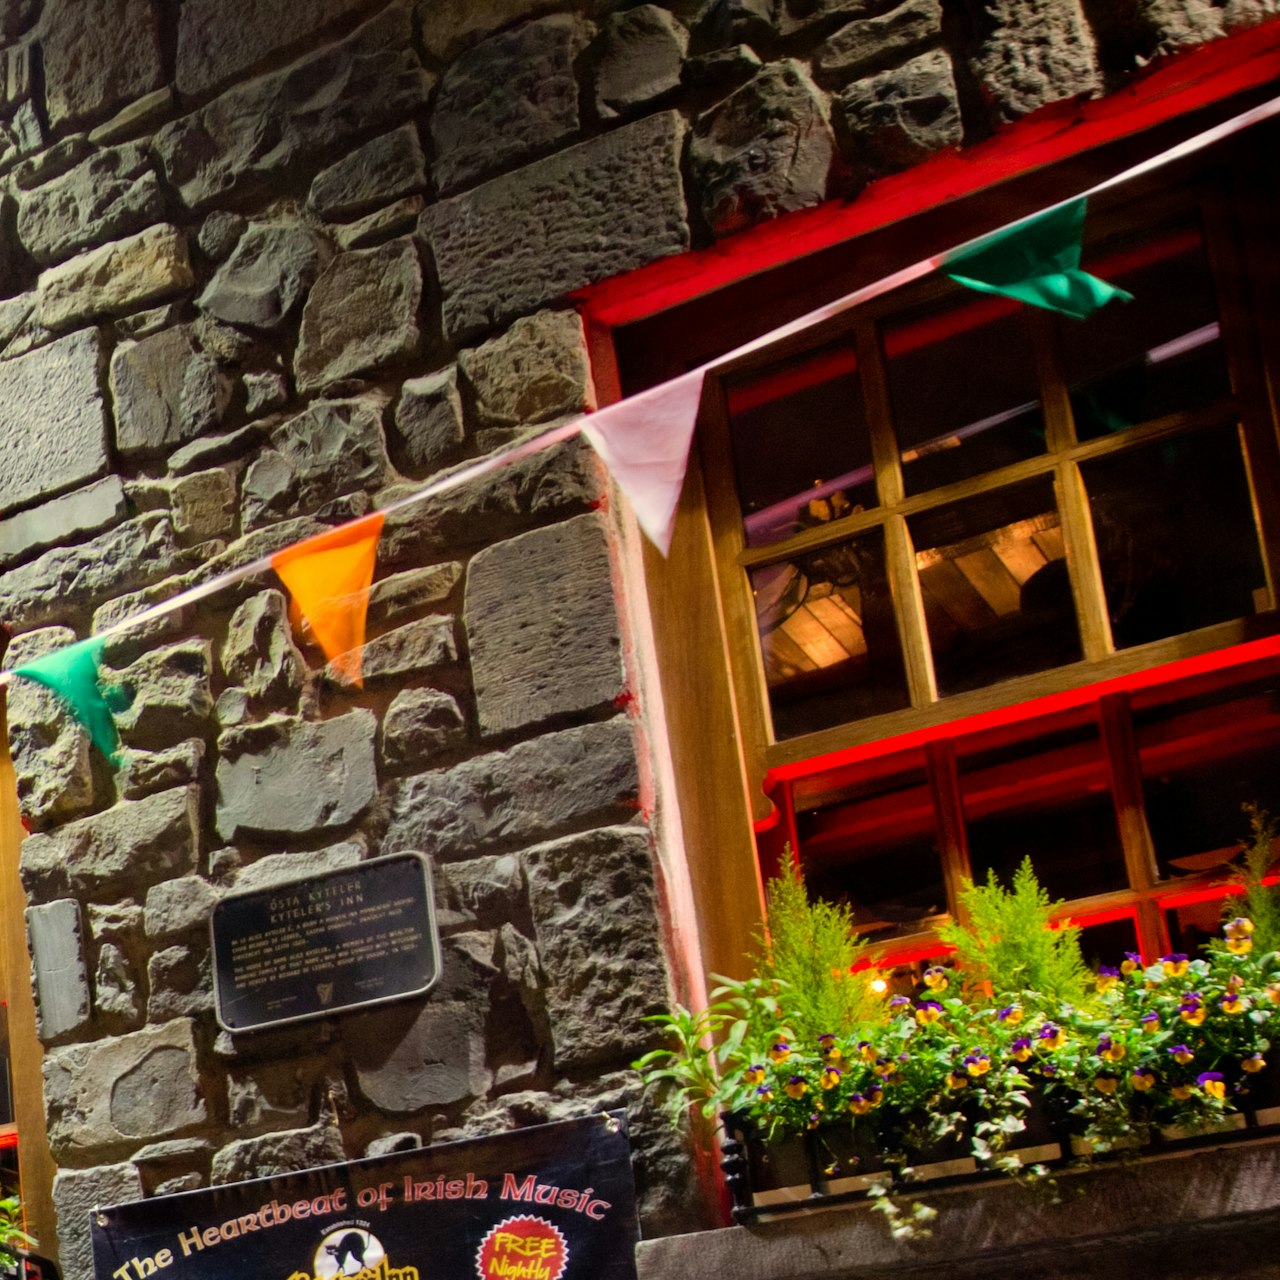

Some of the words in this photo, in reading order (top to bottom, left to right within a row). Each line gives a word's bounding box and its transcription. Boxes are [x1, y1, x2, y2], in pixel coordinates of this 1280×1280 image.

[339, 894, 364, 912] INN
[177, 1187, 348, 1257] Heartbeat
[357, 1182, 393, 1211] of
[404, 1172, 488, 1202] Irish
[500, 1173, 612, 1221] Music
[494, 1231, 558, 1257] FREE
